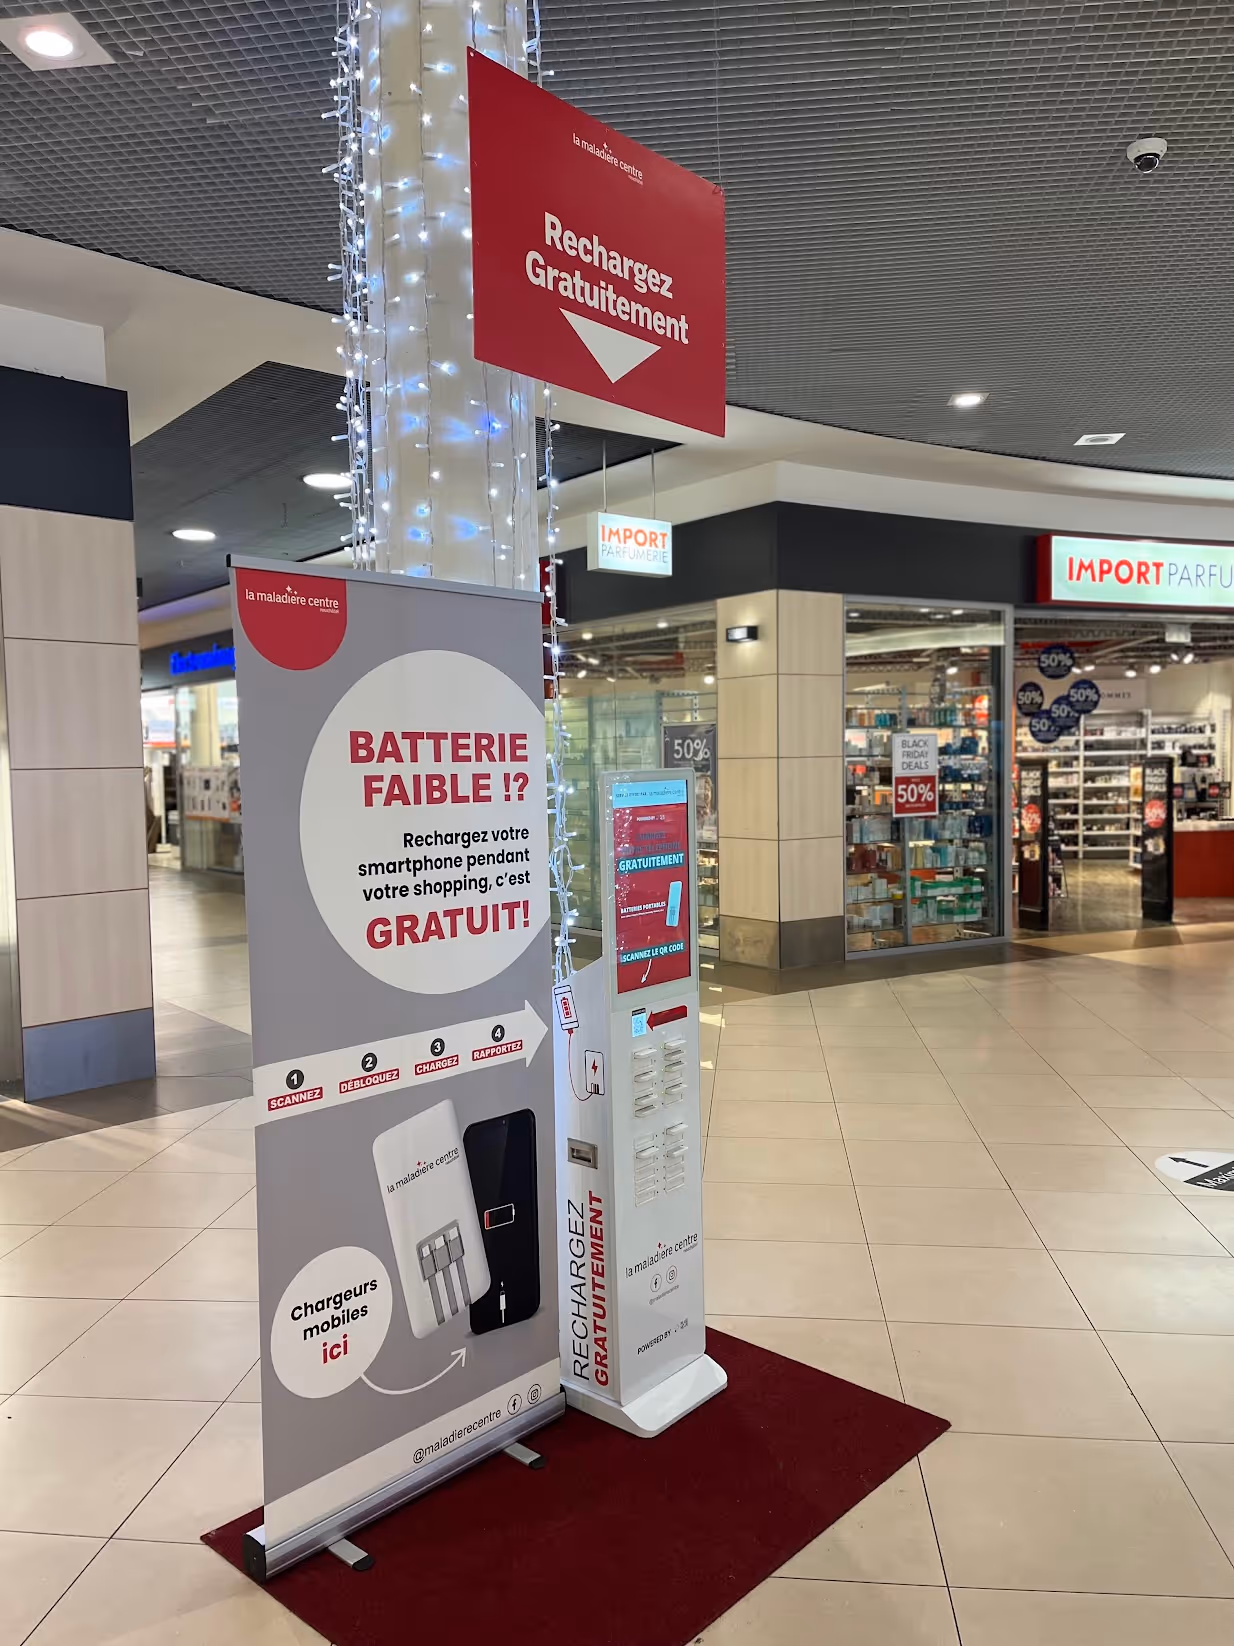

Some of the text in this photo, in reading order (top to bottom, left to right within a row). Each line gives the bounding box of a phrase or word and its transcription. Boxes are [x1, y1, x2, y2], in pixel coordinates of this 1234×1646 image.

[573, 132, 581, 147] la
[619, 160, 643, 180] centre
[544, 211, 673, 299] Rechargez
[525, 250, 689, 345] Gratuitement
[601, 524, 668, 549] IMPORT
[601, 543, 669, 564] PARFUMERIE
[1067, 556, 1234, 589] IMPORT PARFU
[245, 588, 255, 601] la
[308, 597, 339, 609] centre
[1040, 653, 1073, 667] 50%
[1018, 690, 1043, 705] 50%
[1069, 688, 1098, 702] 50%
[349, 731, 529, 763] BATTERIE
[673, 738, 710, 759] 50%
[901, 739, 929, 749] BLACK
[901, 750, 928, 759] FRIDAY
[901, 760, 929, 770] DEALS
[363, 772, 529, 807] FAIBLE !?
[897, 783, 934, 803] 50%
[403, 826, 530, 848] Rechargez votre
[358, 848, 530, 877] smartphone pendant
[618, 853, 684, 872] GRATUITEMENT
[362, 883, 409, 902] votre
[413, 874, 492, 898] shopping,
[366, 900, 530, 950] GRATUIT!
[622, 942, 684, 963] SCANNEZ LE QR CODE
[494, 1028, 501, 1038] 4
[434, 1042, 441, 1052] 3
[473, 1041, 522, 1060] RAPPORTEZ
[365, 1057, 373, 1068] 2
[416, 1057, 458, 1074] CHARGEZ
[290, 1073, 298, 1085] 1
[340, 1070, 399, 1093] DÉBLOQUEZ
[270, 1089, 321, 1109] SCANNEZ
[386, 1185, 395, 1194] la
[435, 1147, 459, 1166] centre
[625, 1267, 634, 1279] la
[674, 1233, 698, 1252] centre
[567, 1199, 590, 1381] RECHARGEZ
[588, 1190, 609, 1387] GRATUITEMENT
[290, 1279, 378, 1321] Chargeurs
[303, 1305, 368, 1341] mobiles
[322, 1333, 348, 1365] ici
[637, 1328, 672, 1355] POWERED BY
[412, 1409, 502, 1464] @maladierecentre
